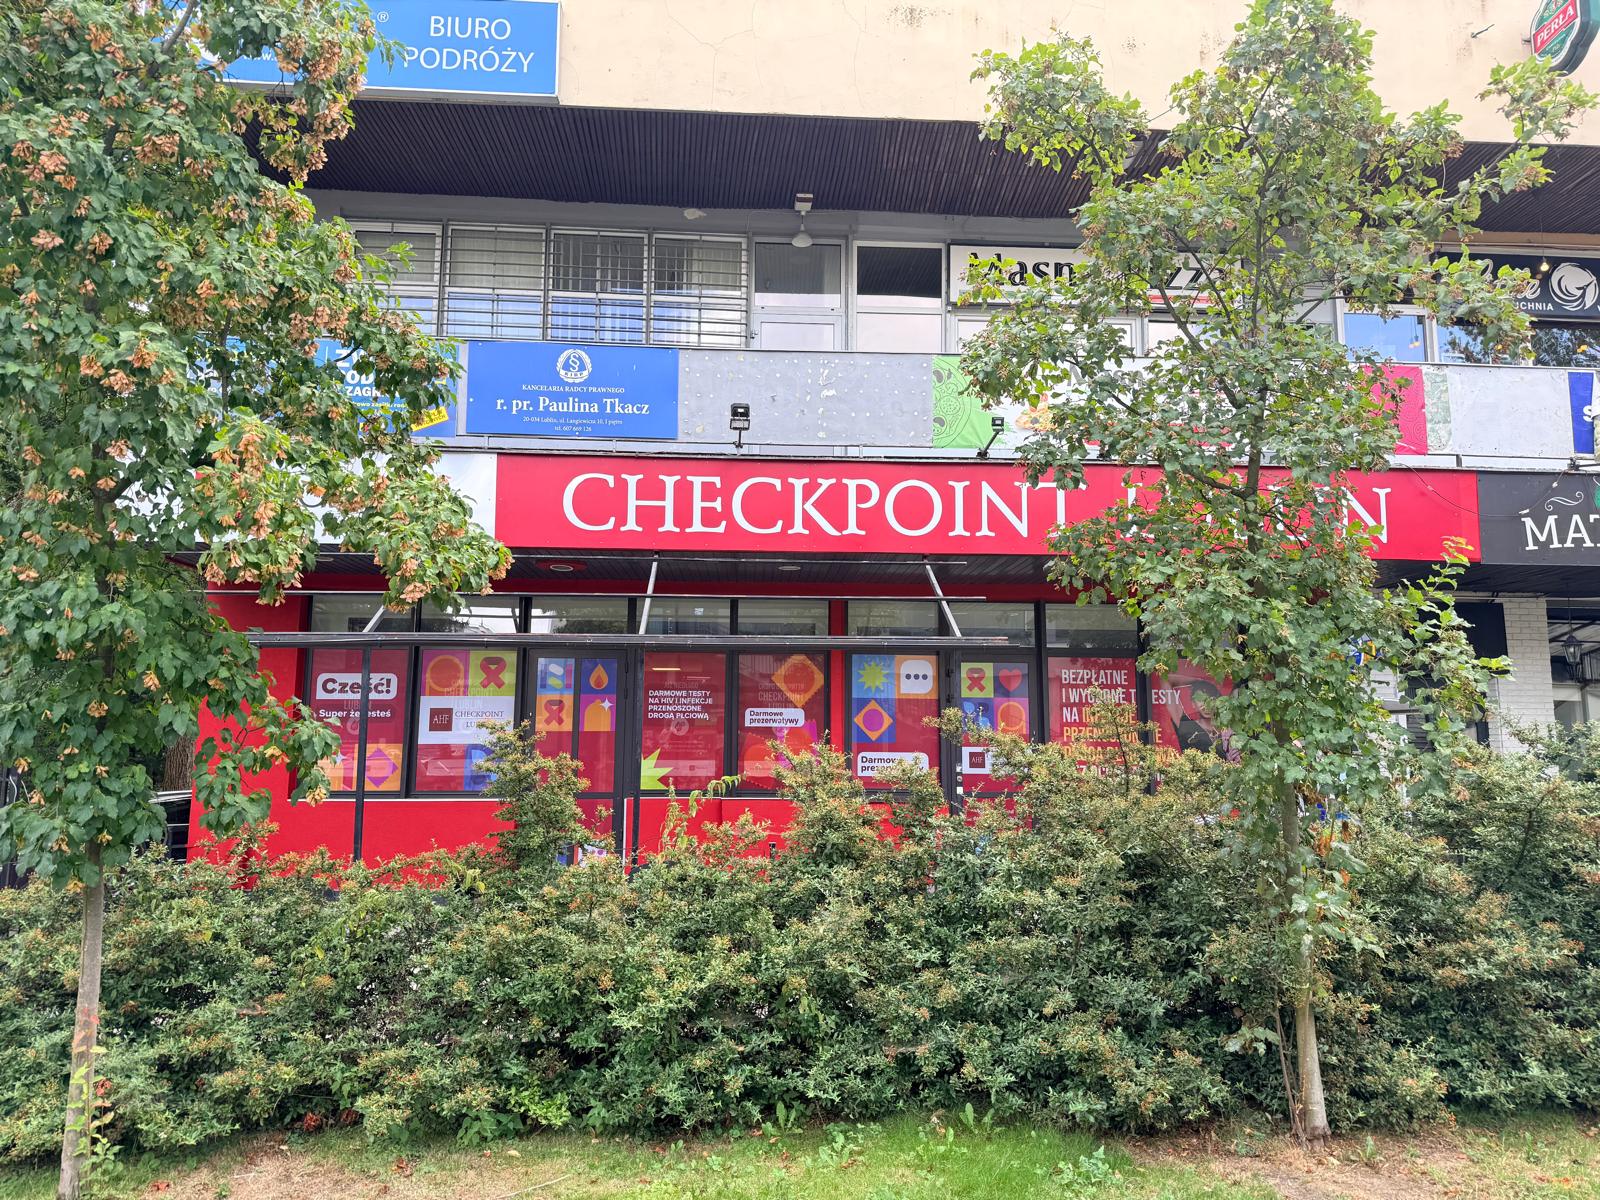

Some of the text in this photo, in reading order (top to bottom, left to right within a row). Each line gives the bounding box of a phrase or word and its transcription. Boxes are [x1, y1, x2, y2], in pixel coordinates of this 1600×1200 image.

[429, 15, 511, 40] BIURO
[404, 46, 535, 73] PODRÓŻY
[522, 384, 564, 392] KANCELARIA
[588, 386, 625, 394] PRAWNEGO
[496, 396, 650, 415] r. pr. Paulina Tkacz
[562, 472, 1087, 538] CHECKPOINT
[1061, 669, 1128, 685] BEZPŁATNE
[319, 709, 347, 719] Super
[433, 714, 450, 724] AHF
[454, 710, 505, 718] CHECKPOINT
[647, 712, 675, 721] DROGĄ
[1063, 707, 1079, 723] NA
[749, 717, 799, 726] prezerwatywy
